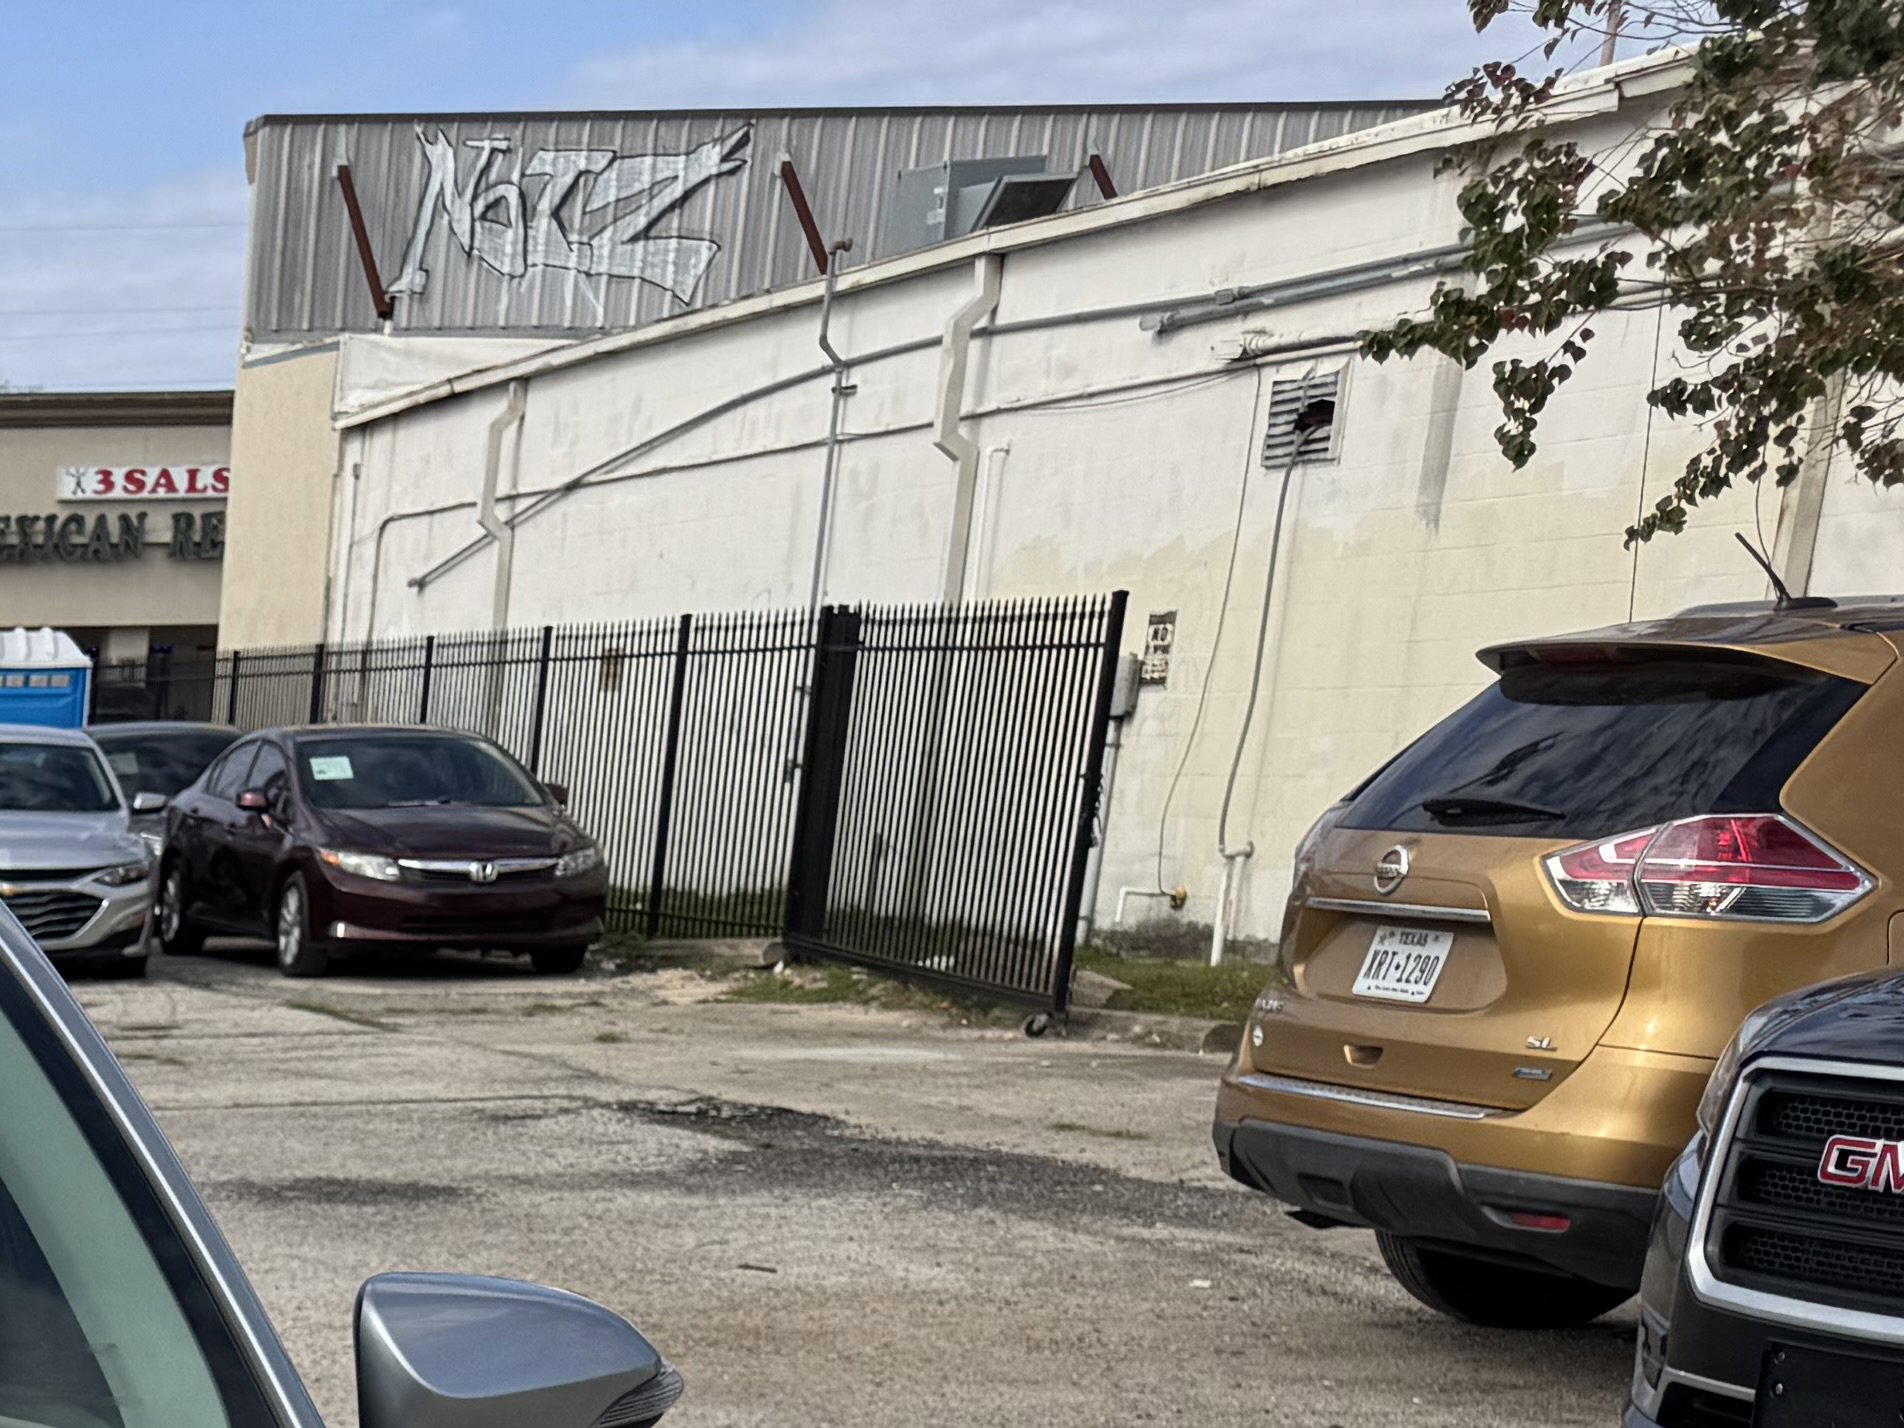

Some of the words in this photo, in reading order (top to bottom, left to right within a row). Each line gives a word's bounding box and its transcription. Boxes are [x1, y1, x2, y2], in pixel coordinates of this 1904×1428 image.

[92, 469, 115, 495] 3
[122, 467, 230, 495] SALS
[1398, 931, 1429, 947] TEXAS
[1817, 1134, 1904, 1194] GM
